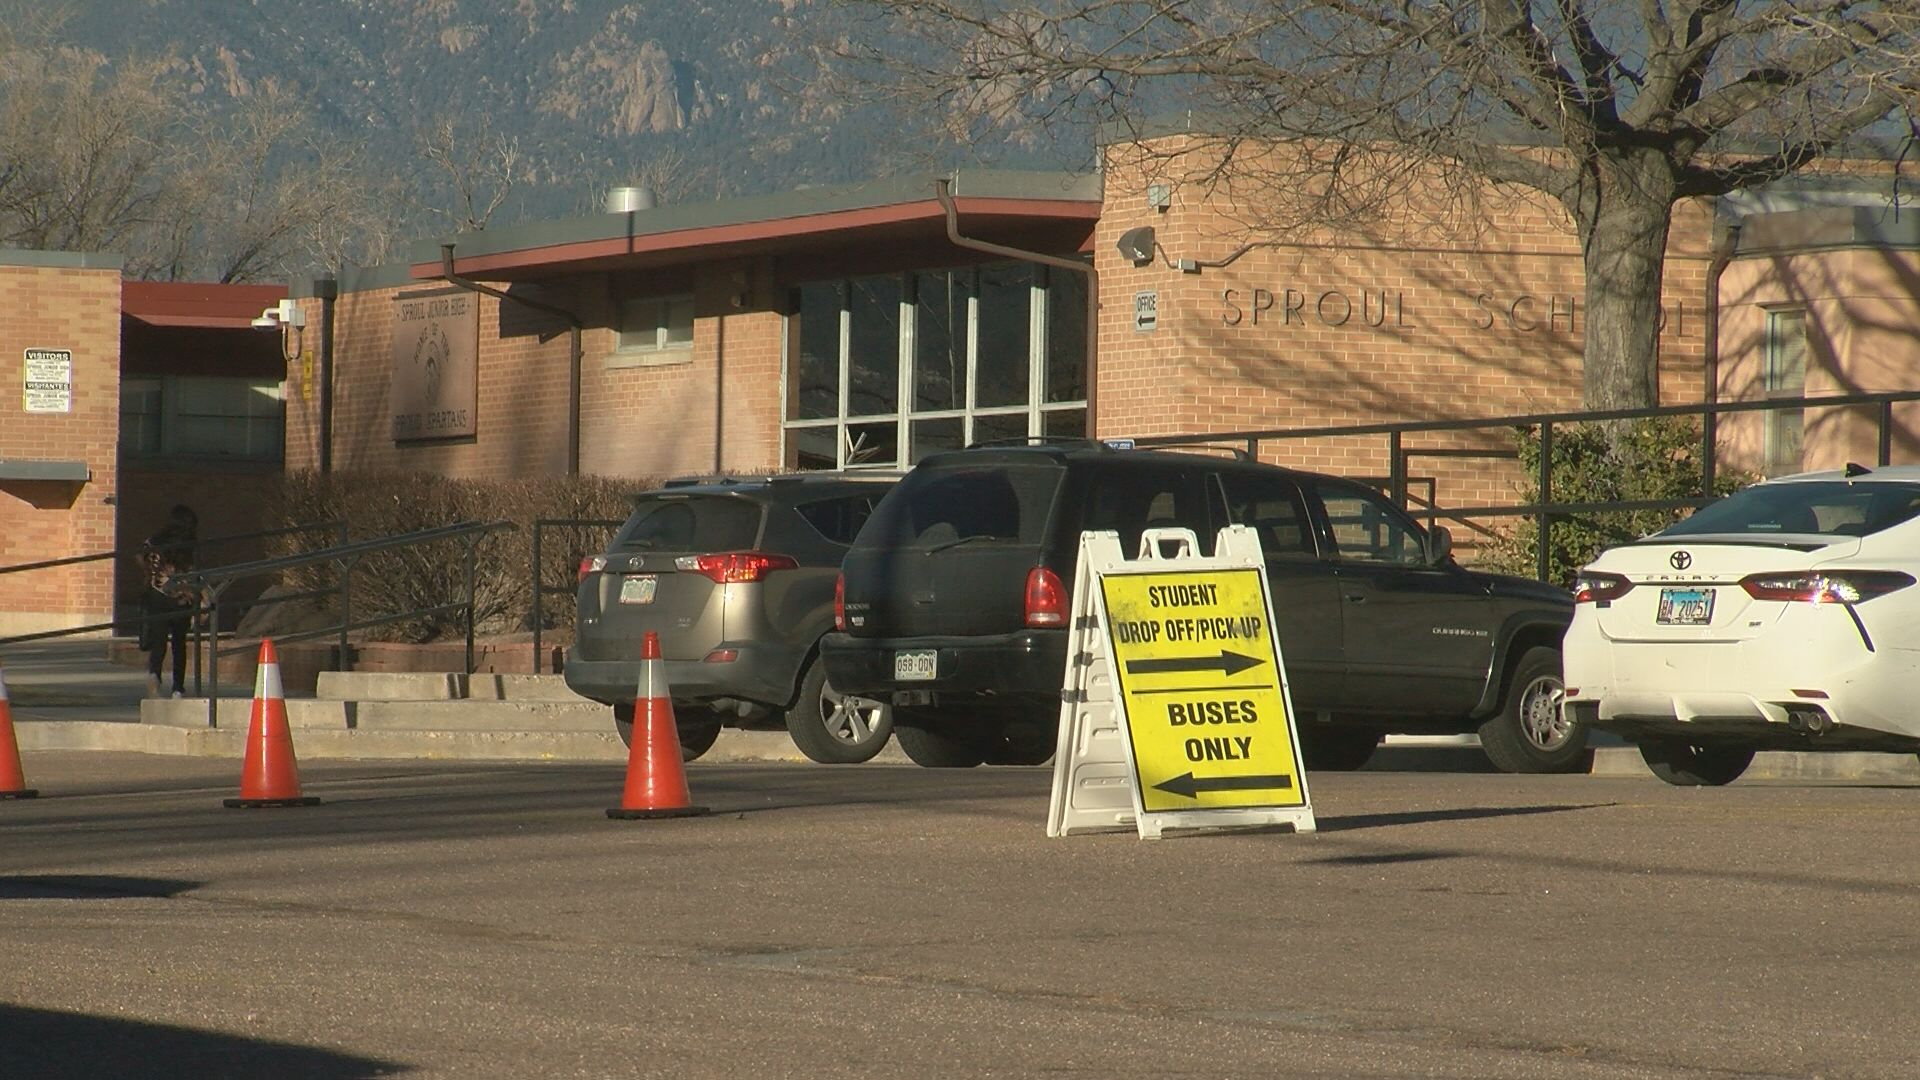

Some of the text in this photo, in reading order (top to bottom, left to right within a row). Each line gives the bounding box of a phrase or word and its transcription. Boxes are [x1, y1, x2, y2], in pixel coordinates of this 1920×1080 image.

[402, 302, 425, 321] SPROUL
[1137, 294, 1156, 312] OFFICE
[1223, 289, 1693, 338] SPROUL SCHL
[28, 352, 69, 361] VISITORS
[426, 409, 467, 431] SPARTANS
[1149, 584, 1218, 608] STUDENT
[1678, 600, 1710, 617] 20251
[1118, 616, 1262, 644] DROP OFF/PICK UP
[1167, 700, 1258, 726] BUSES
[1185, 736, 1252, 762] ONLY
